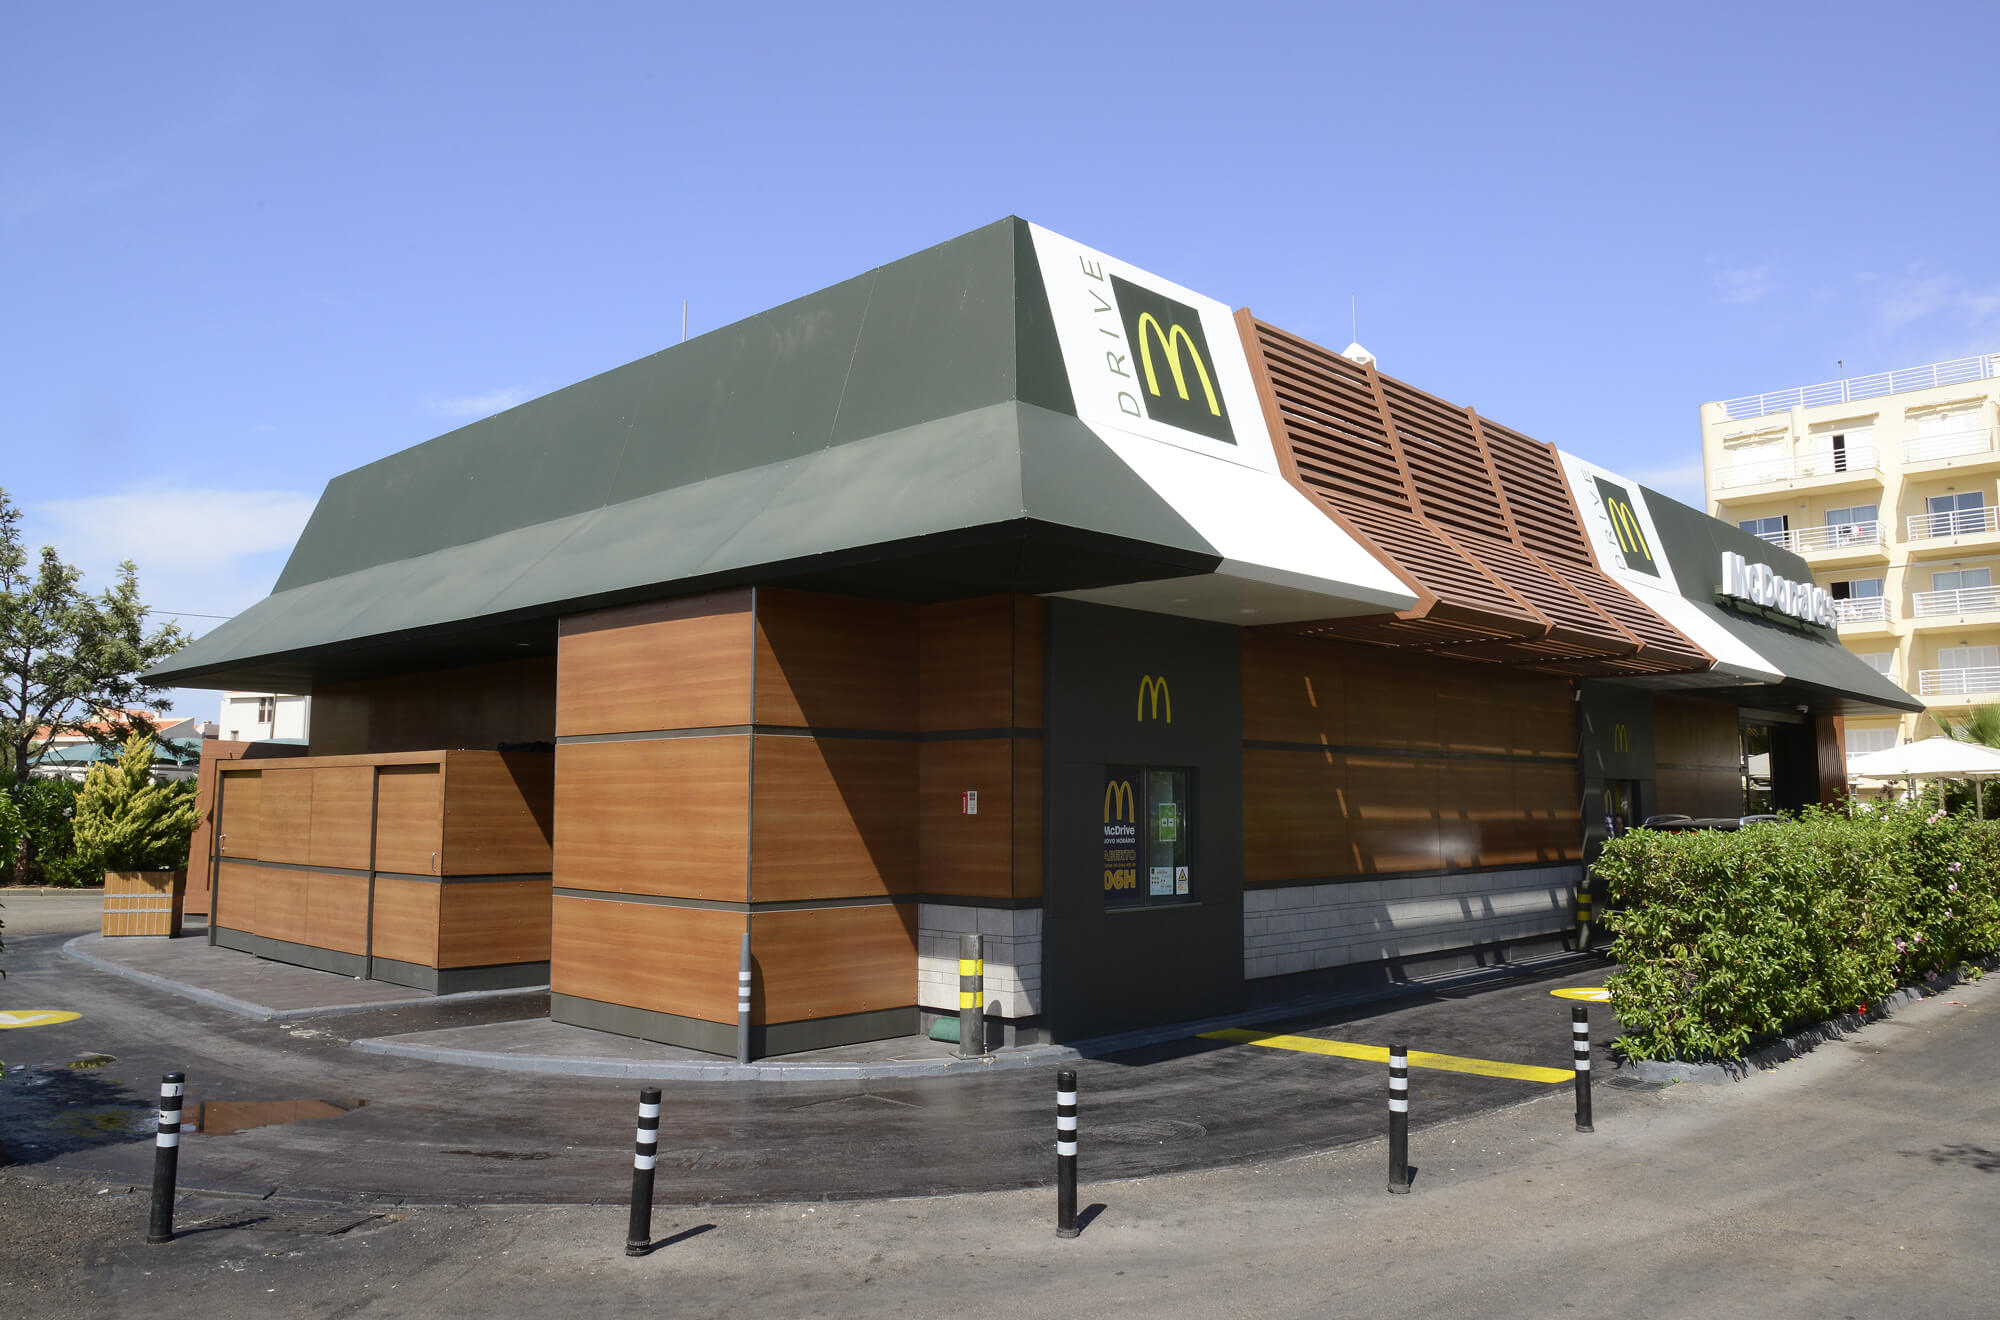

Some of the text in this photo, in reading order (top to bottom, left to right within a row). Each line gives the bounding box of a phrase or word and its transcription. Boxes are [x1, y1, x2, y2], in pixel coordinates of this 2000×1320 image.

[1079, 255, 1142, 418] DRIVE
[1580, 467, 1627, 571] DRIVE
[1104, 825, 1136, 836] McDrive
